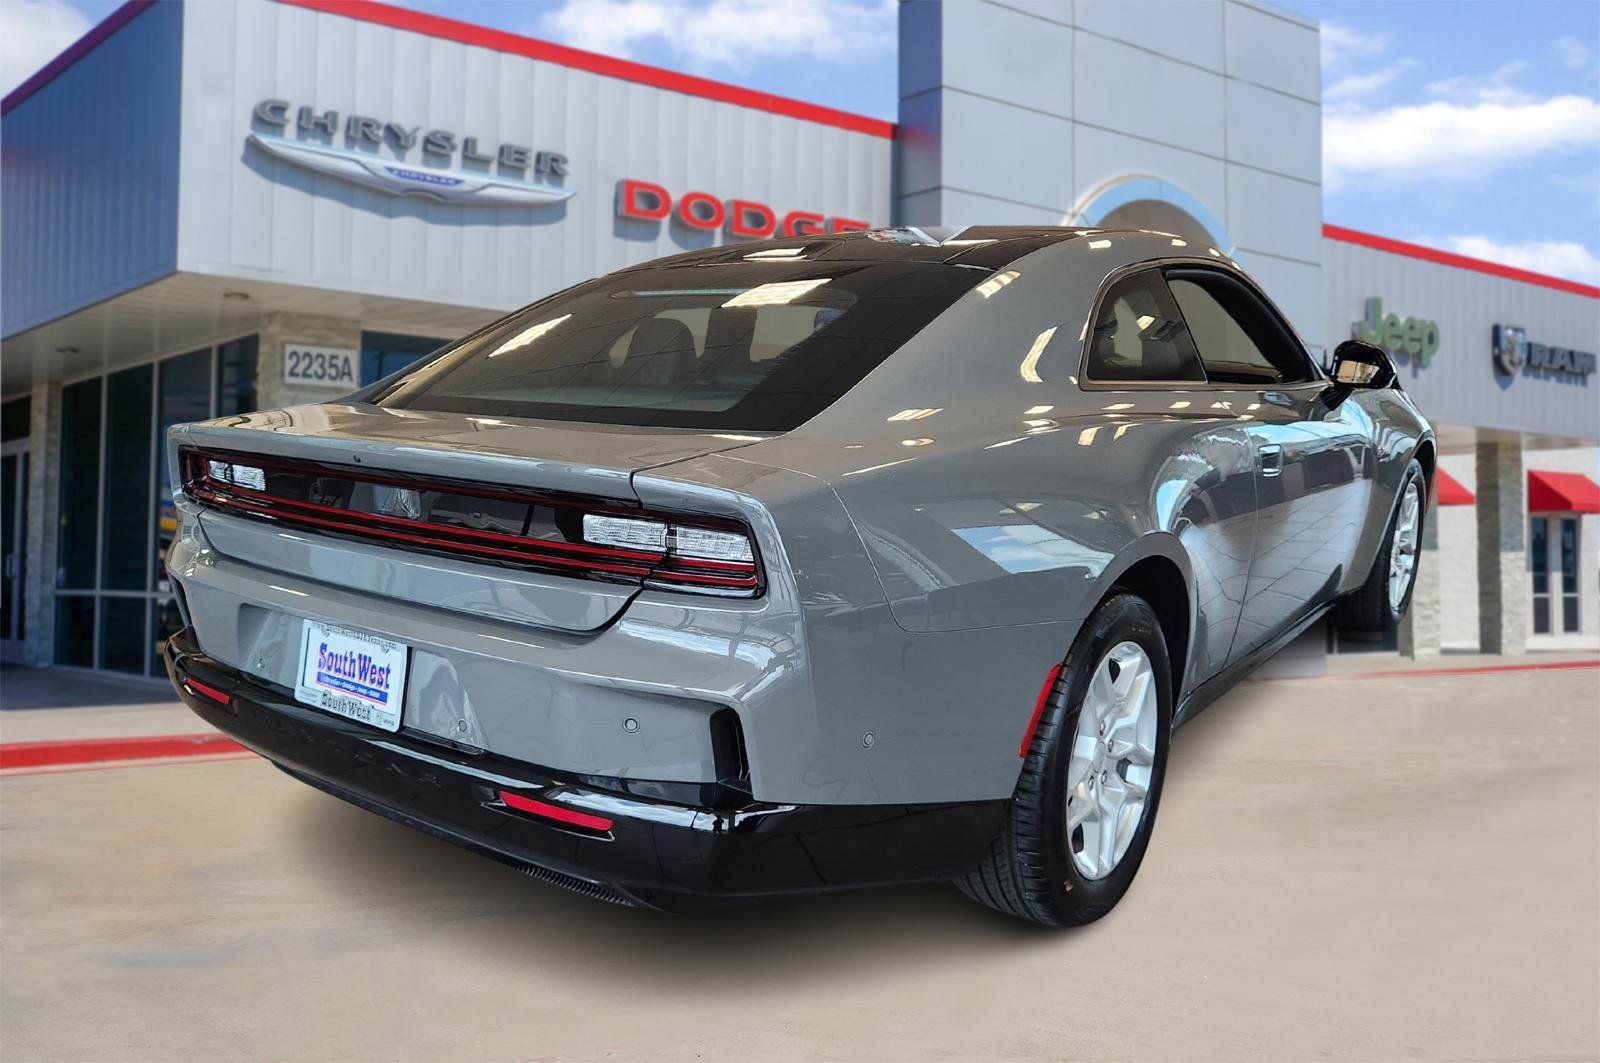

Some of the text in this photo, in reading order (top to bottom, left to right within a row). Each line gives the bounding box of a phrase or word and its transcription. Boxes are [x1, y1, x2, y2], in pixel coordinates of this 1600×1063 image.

[251, 98, 568, 176] CHRYSLER
[1354, 296, 1440, 365] Jeep
[288, 351, 353, 381] 2235A
[1527, 342, 1597, 374] RAM
